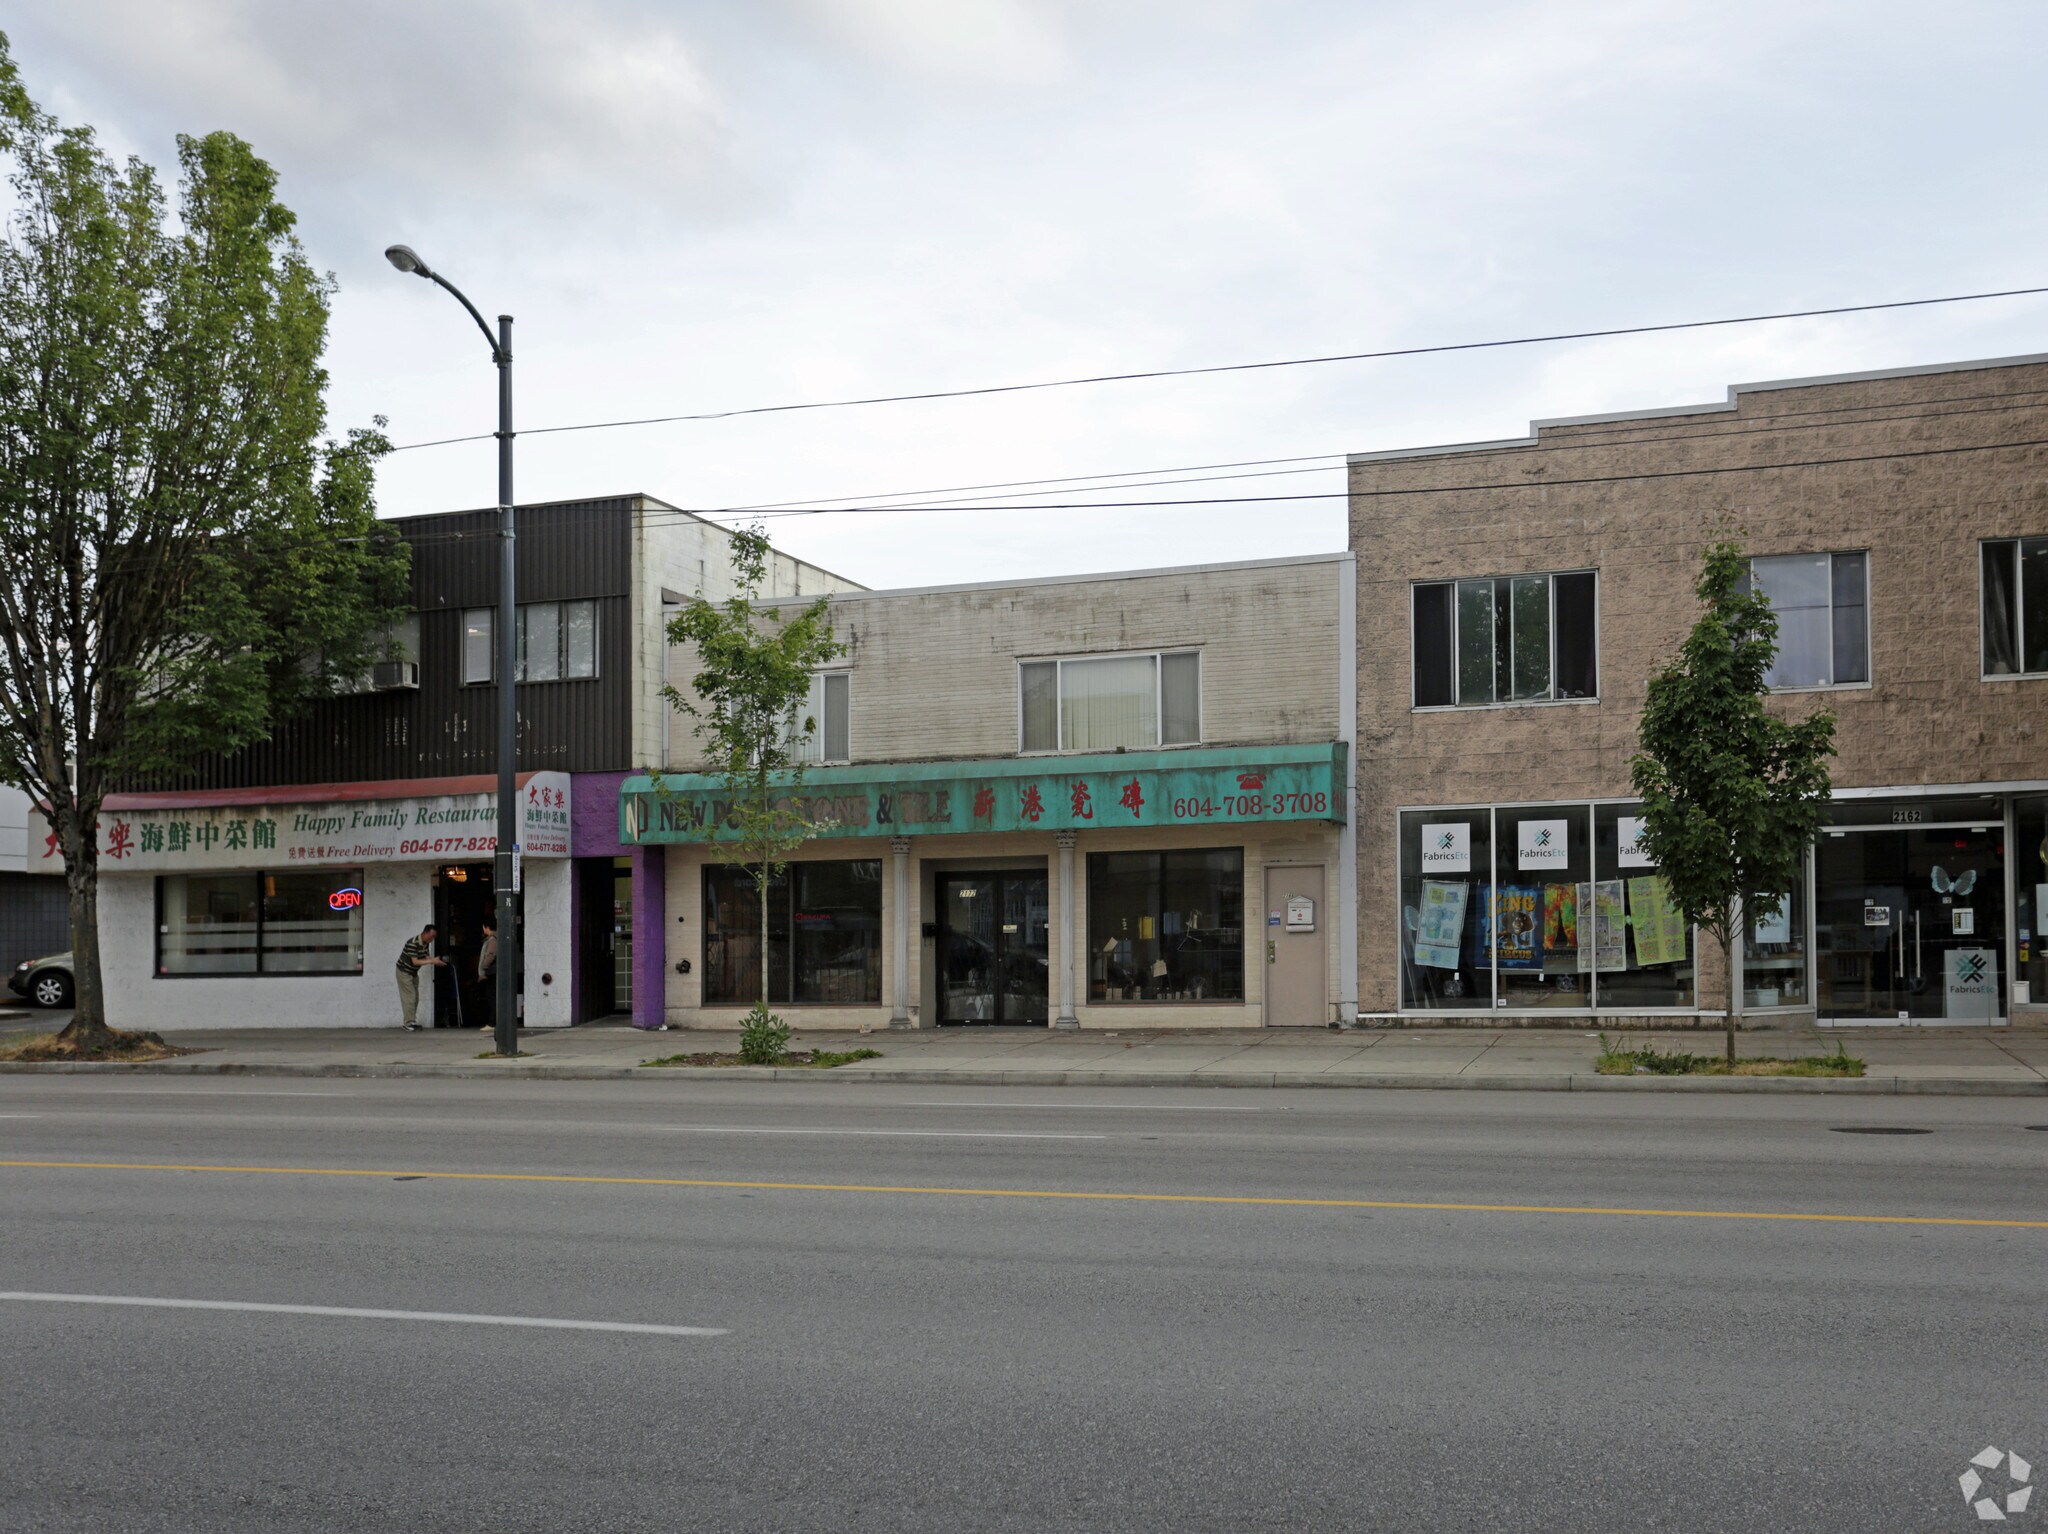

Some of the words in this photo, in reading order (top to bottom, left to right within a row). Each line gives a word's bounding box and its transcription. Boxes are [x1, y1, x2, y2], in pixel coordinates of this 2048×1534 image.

[659, 800, 707, 832] NEW
[876, 793, 893, 824] &
[1173, 792, 1327, 818] 604-708-3708
[1893, 811, 1921, 823] 2162
[293, 813, 345, 835] Happy
[351, 807, 408, 830] Family
[415, 806, 499, 825] Restauran
[140, 818, 277, 853] 海鮮中菜館
[327, 845, 351, 858] Free
[353, 845, 396, 858] Delivery
[400, 837, 498, 854] 604-677-828
[329, 893, 361, 906] OPEN
